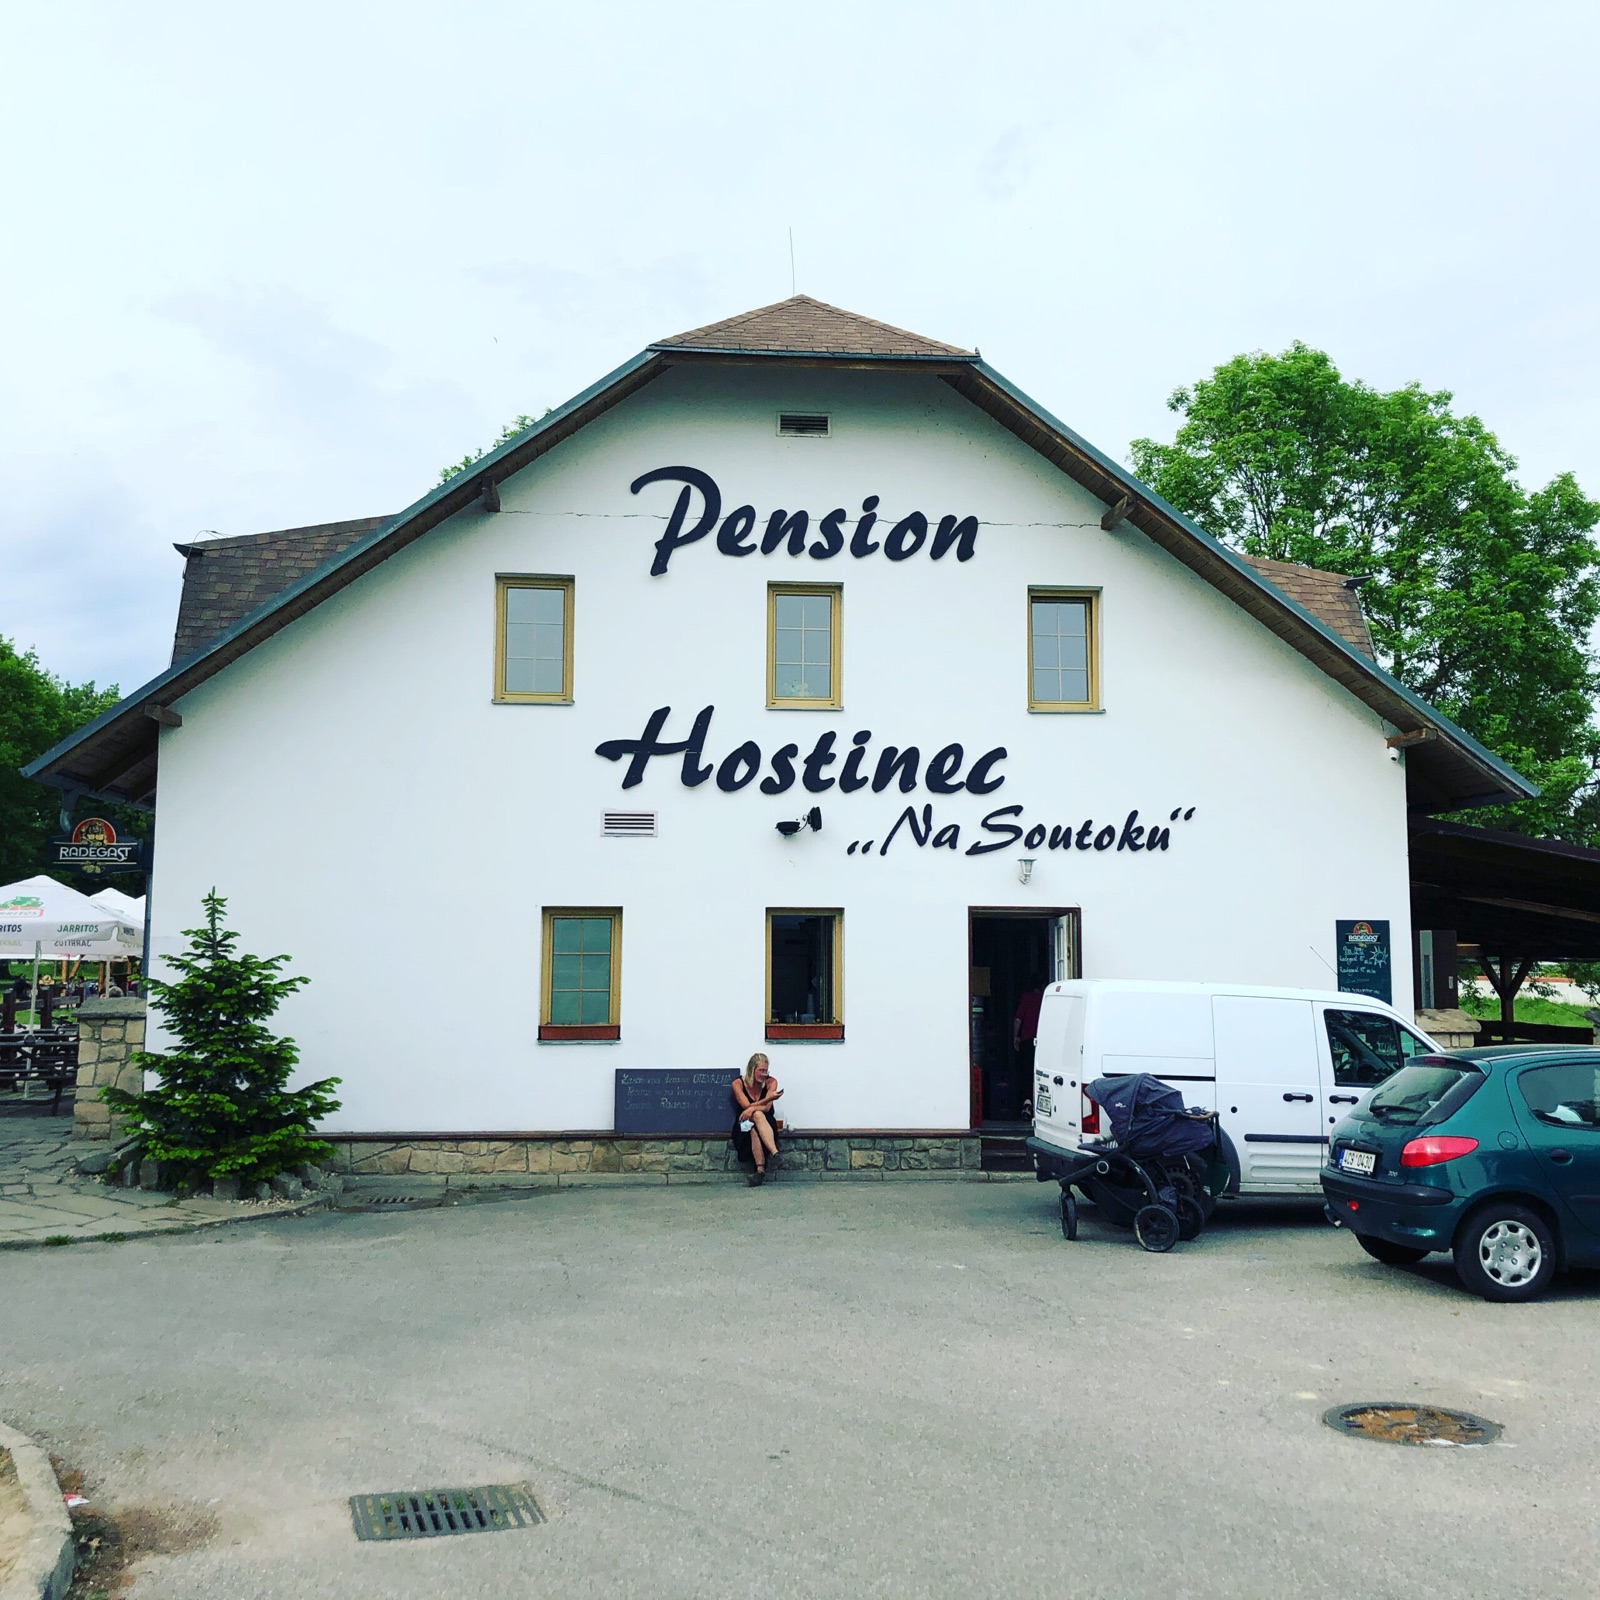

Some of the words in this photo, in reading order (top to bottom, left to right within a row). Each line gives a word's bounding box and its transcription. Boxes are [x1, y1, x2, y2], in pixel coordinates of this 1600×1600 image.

[631, 466, 980, 577] Pension
[595, 705, 1008, 795] Hostinec
[59, 847, 132, 862] RADEGAST
[57, 924, 99, 933] JARRITOS
